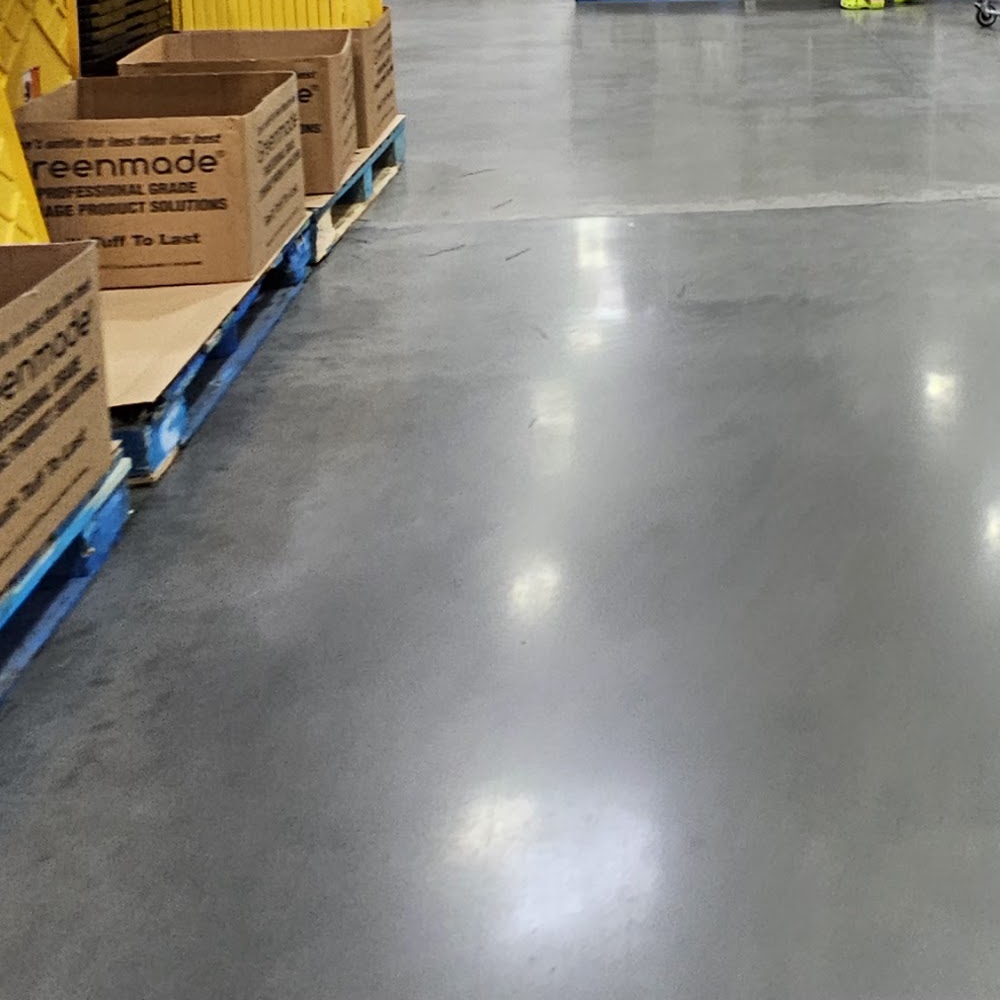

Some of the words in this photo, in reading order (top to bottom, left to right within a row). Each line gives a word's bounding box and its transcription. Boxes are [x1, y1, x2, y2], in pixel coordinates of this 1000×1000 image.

[148, 182, 198, 195] GRADE
[131, 234, 153, 246] To
[159, 232, 201, 245] Last
